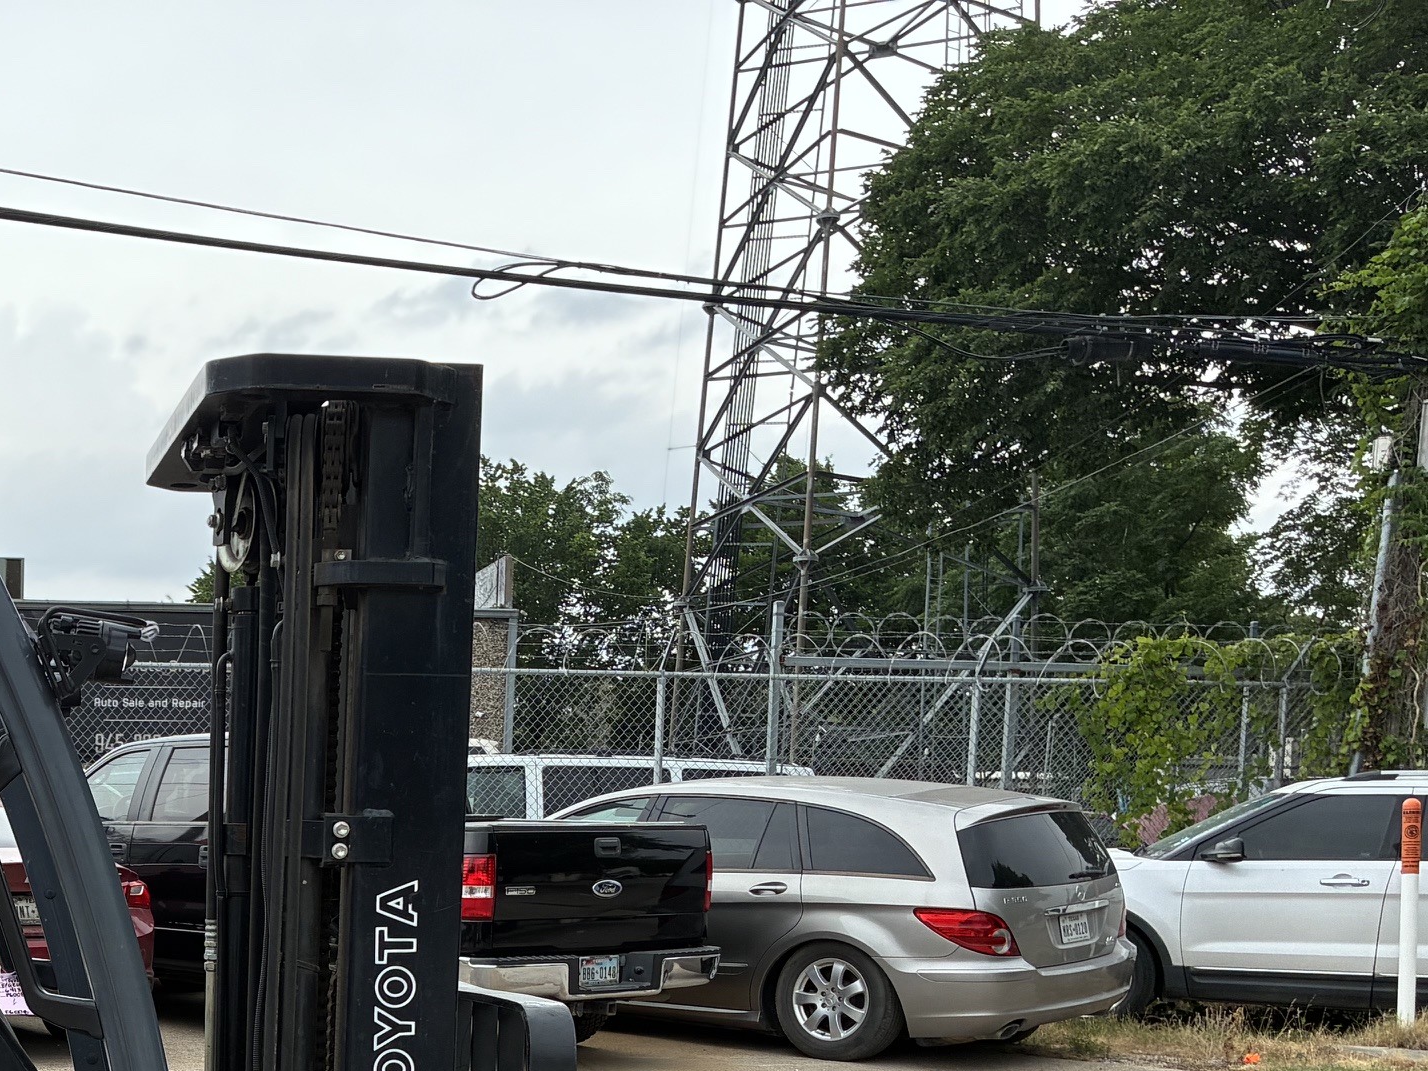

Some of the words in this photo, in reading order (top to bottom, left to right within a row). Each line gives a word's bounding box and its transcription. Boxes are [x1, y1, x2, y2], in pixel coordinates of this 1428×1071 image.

[94, 698, 119, 708] Auto
[122, 698, 145, 708] Sale
[148, 698, 168, 708] and
[172, 698, 206, 710] Repair
